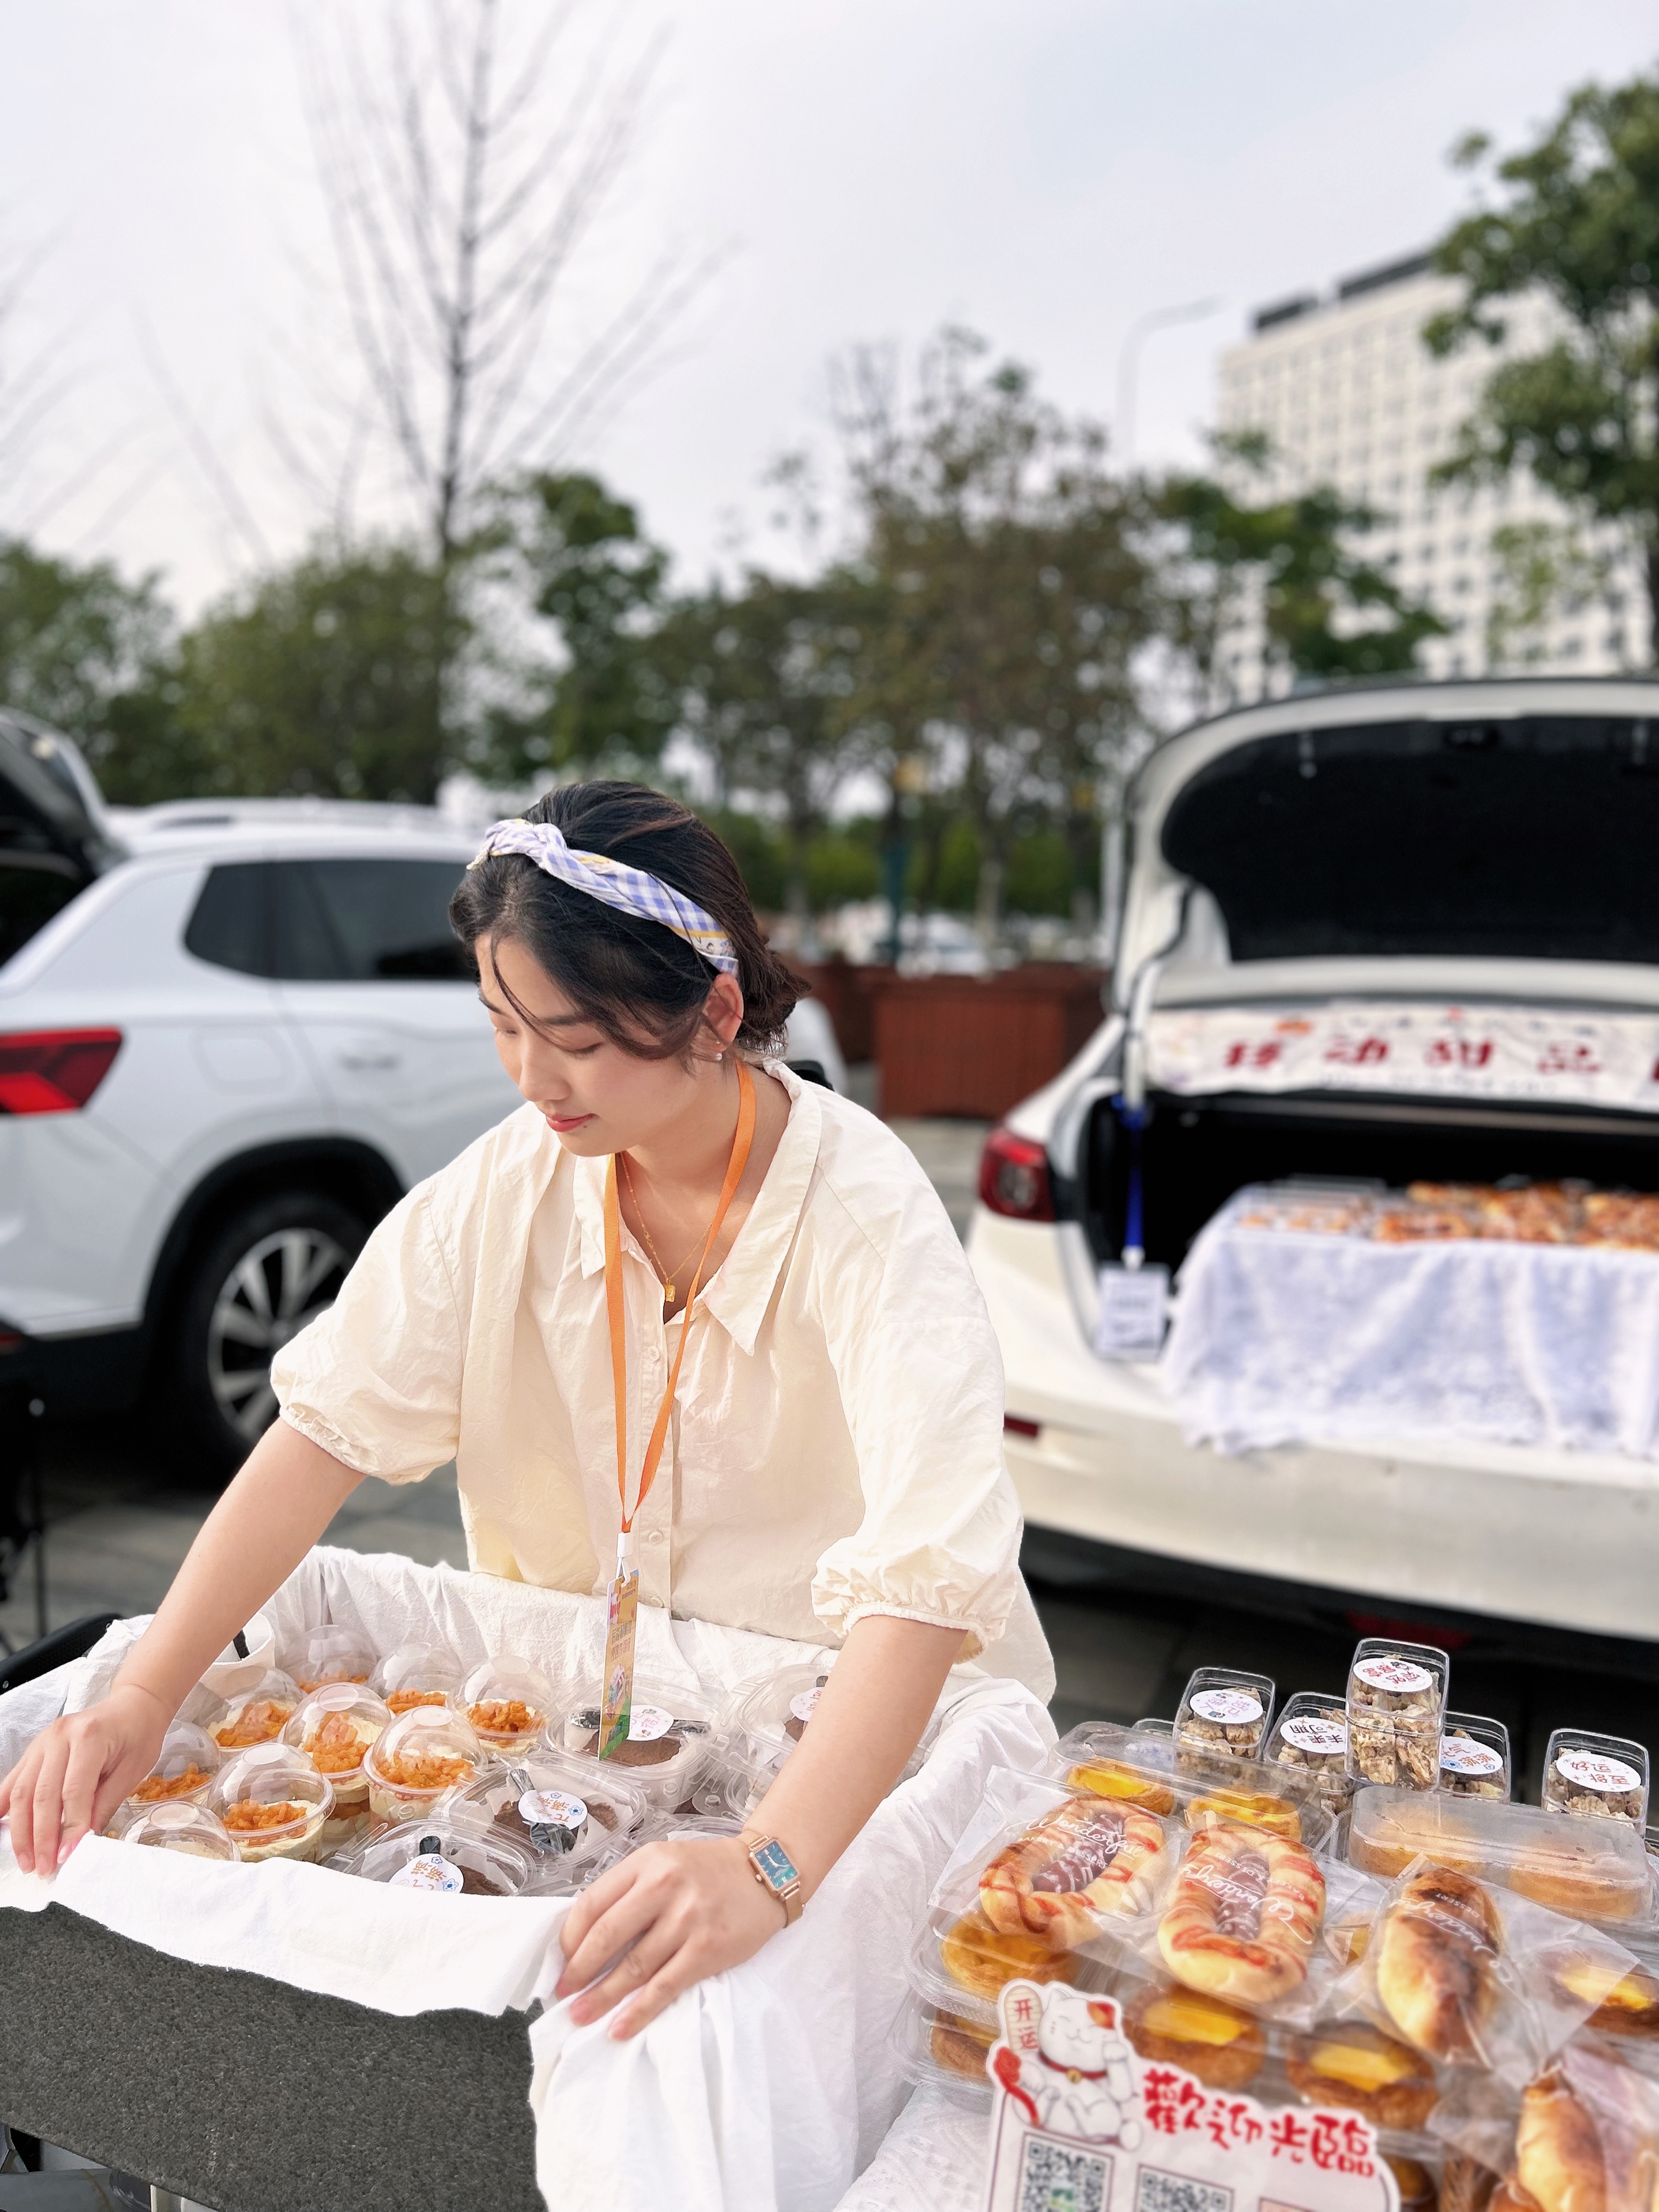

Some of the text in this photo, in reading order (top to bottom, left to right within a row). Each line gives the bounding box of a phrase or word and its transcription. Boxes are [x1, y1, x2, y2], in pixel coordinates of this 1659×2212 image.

[1570, 1760, 1612, 1773] 好运
[1003, 1813, 1144, 1857] Wonderful
[1067, 1846, 1108, 1869] DESSERT
[1014, 1997, 1040, 2050] 开运
